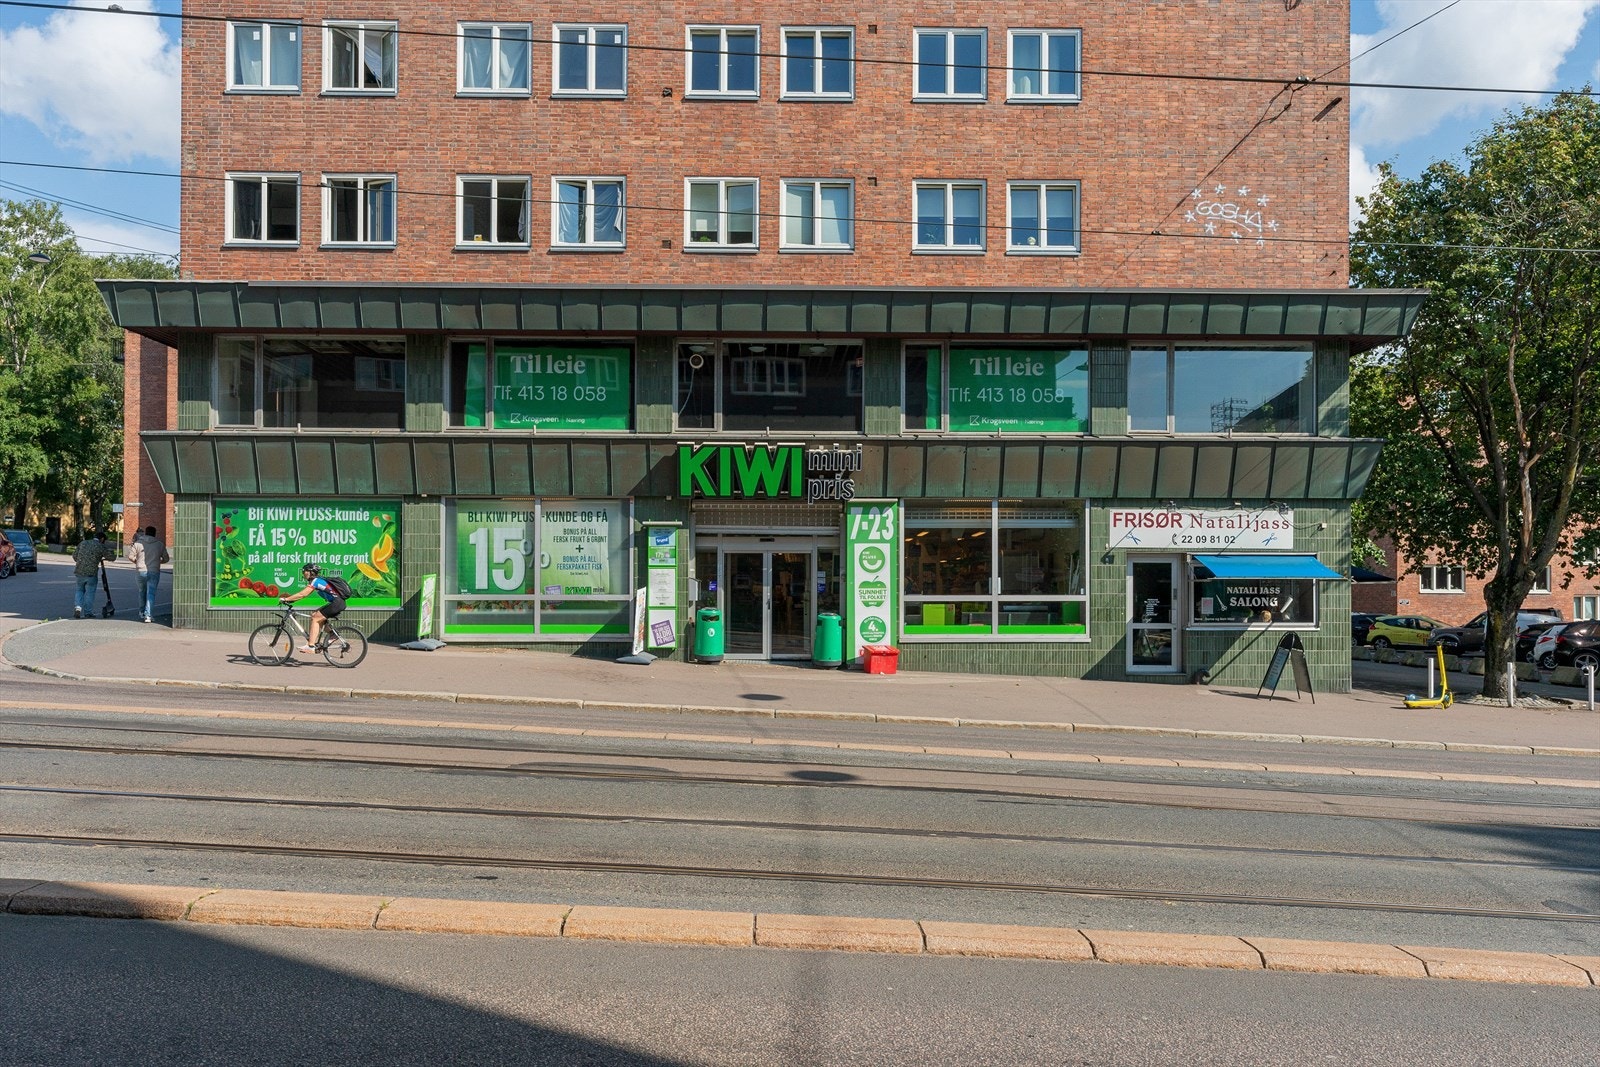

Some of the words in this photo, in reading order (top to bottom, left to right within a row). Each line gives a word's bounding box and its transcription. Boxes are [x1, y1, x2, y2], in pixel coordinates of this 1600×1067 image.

[510, 354, 542, 374] Til
[545, 354, 586, 374] leie
[970, 356, 1001, 376] Til
[1004, 356, 1044, 376] leie
[493, 386, 512, 400] Tlf.
[518, 386, 544, 400] 413
[550, 386, 567, 400] 18
[574, 386, 606, 401] 058
[950, 388, 971, 402] Tlf.
[976, 388, 1004, 402] 413
[1009, 388, 1026, 402] 18
[1032, 388, 1064, 402] 058
[982, 416, 1018, 426] Krogsveen
[808, 443, 863, 472] mini
[678, 442, 805, 498] KIWI
[808, 472, 856, 505] pris
[248, 507, 264, 521] Bli
[266, 507, 294, 521] KIWI
[296, 507, 370, 522] PLUSS-kunde
[468, 511, 484, 522] BLI
[486, 511, 508, 522] KIWI
[580, 511, 594, 522] OG
[596, 508, 608, 522] FÅ
[1112, 512, 1182, 529] FRISØR
[1190, 513, 1290, 533] Natalijass
[248, 522, 267, 546] FÅ
[270, 528, 286, 546] 15
[312, 529, 358, 545] BONUS
[563, 528, 580, 536] BONUS
[580, 527, 588, 536] PÅ
[588, 528, 598, 536] ALL
[591, 536, 608, 544] GRØNT
[1181, 536, 1194, 544] 22
[1195, 536, 1207, 544] 09
[1209, 536, 1221, 544] 81
[1224, 536, 1236, 544] 02
[248, 551, 261, 565] på
[262, 552, 275, 564] all
[276, 552, 301, 564] fersk
[303, 552, 328, 564] frukt
[330, 555, 340, 565] og
[342, 552, 369, 566] grønt
[580, 554, 588, 562] PÅ
[564, 586, 592, 594] KIWI
[1226, 586, 1258, 594] NATALI
[1260, 586, 1280, 594] JASS
[1229, 597, 1278, 607] SALONG
